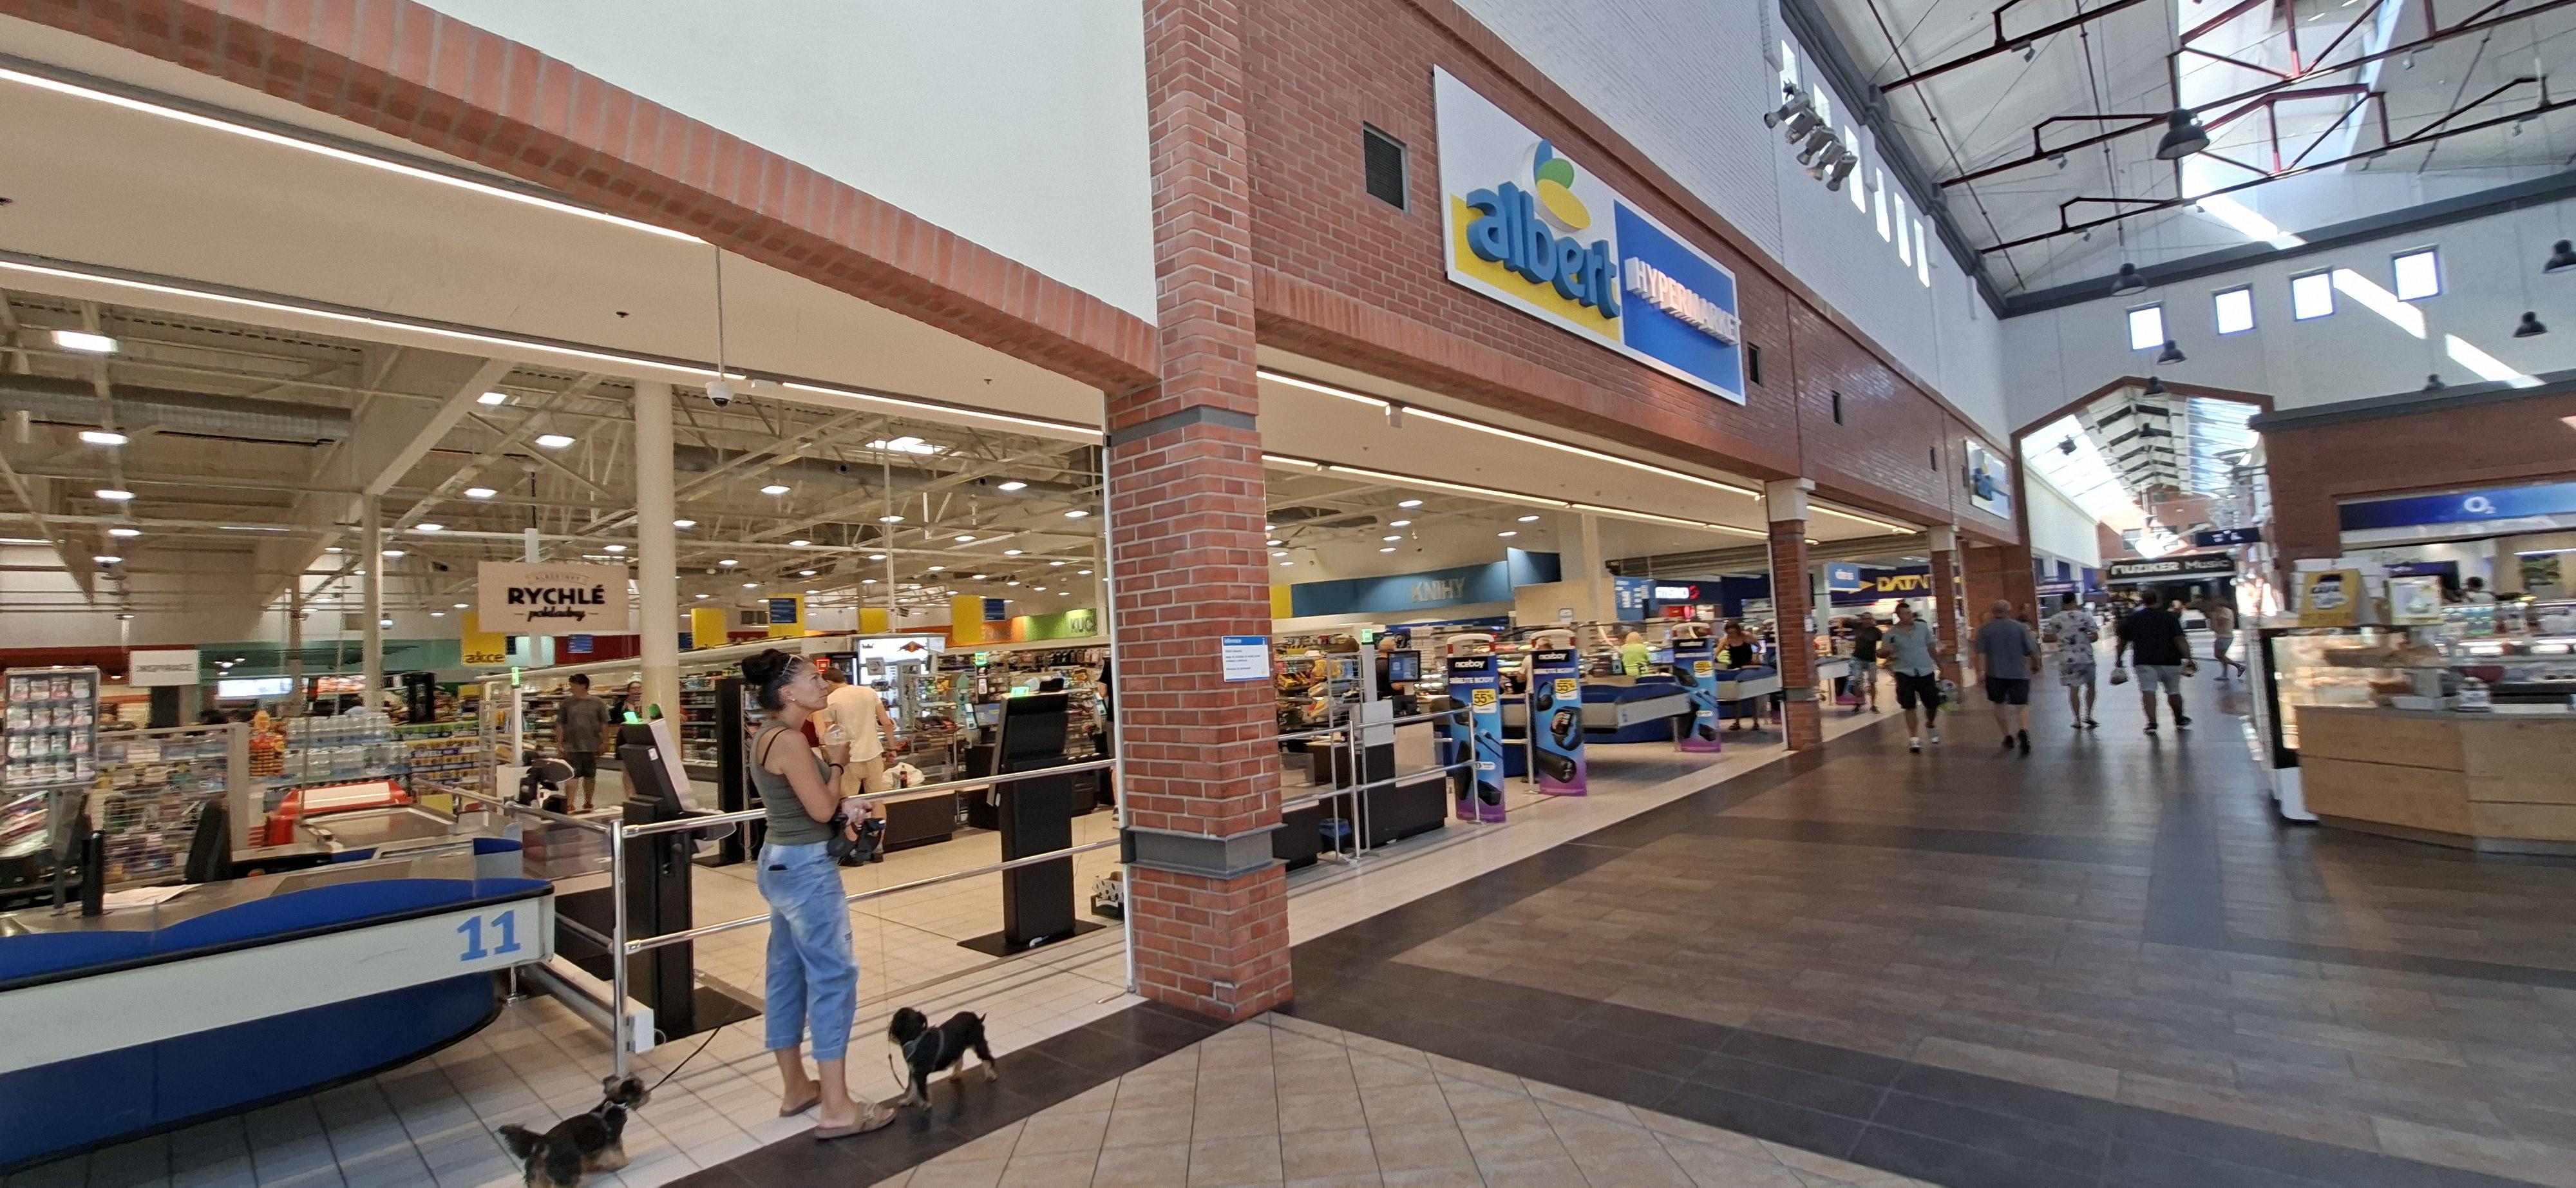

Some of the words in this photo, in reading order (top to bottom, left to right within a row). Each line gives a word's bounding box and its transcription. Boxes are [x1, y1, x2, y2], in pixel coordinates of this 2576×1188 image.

[1466, 181, 1620, 319] albert
[1625, 257, 1741, 346] HYPERMARKET
[508, 584, 605, 604] RYCHLÉ
[1411, 577, 1466, 602] KNIHY
[457, 910, 521, 961] 11
